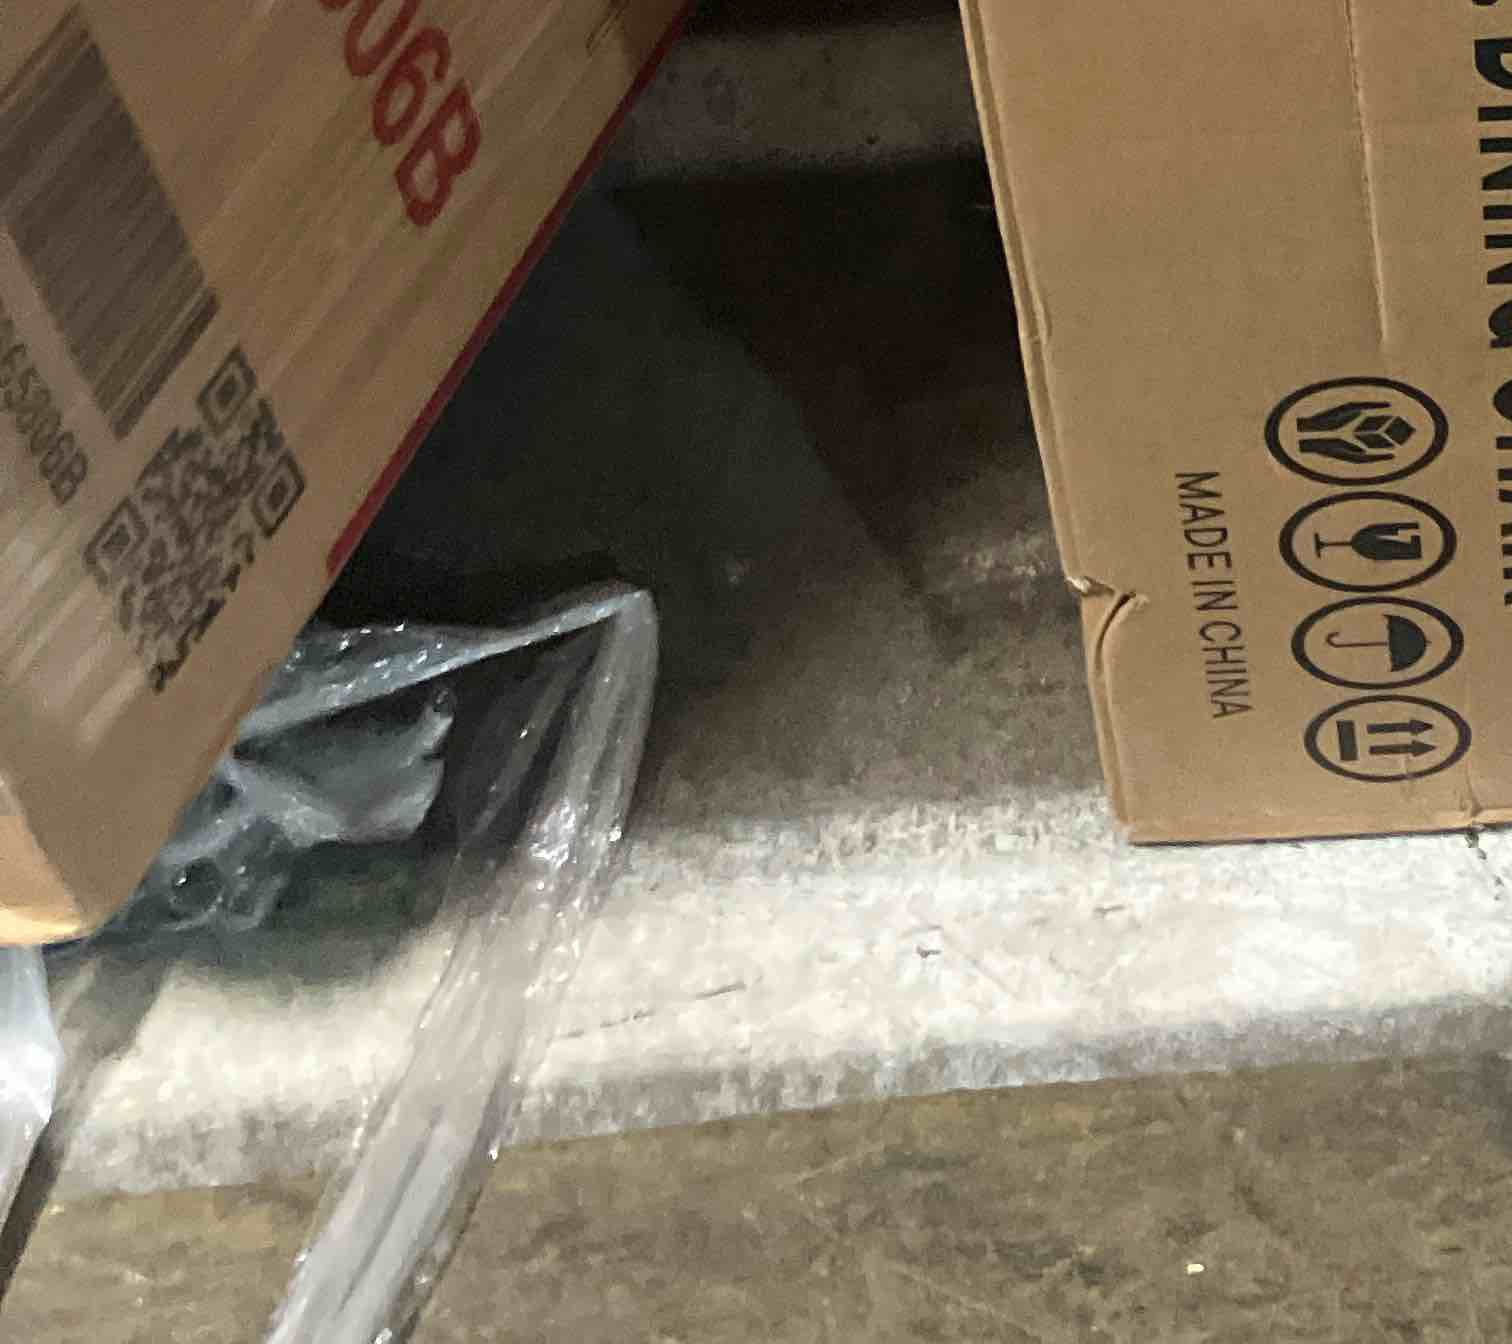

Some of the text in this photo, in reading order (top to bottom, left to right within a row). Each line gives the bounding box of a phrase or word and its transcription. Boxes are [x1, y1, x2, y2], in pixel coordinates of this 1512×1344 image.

[1174, 471, 1253, 719] MADE IN CHINA
